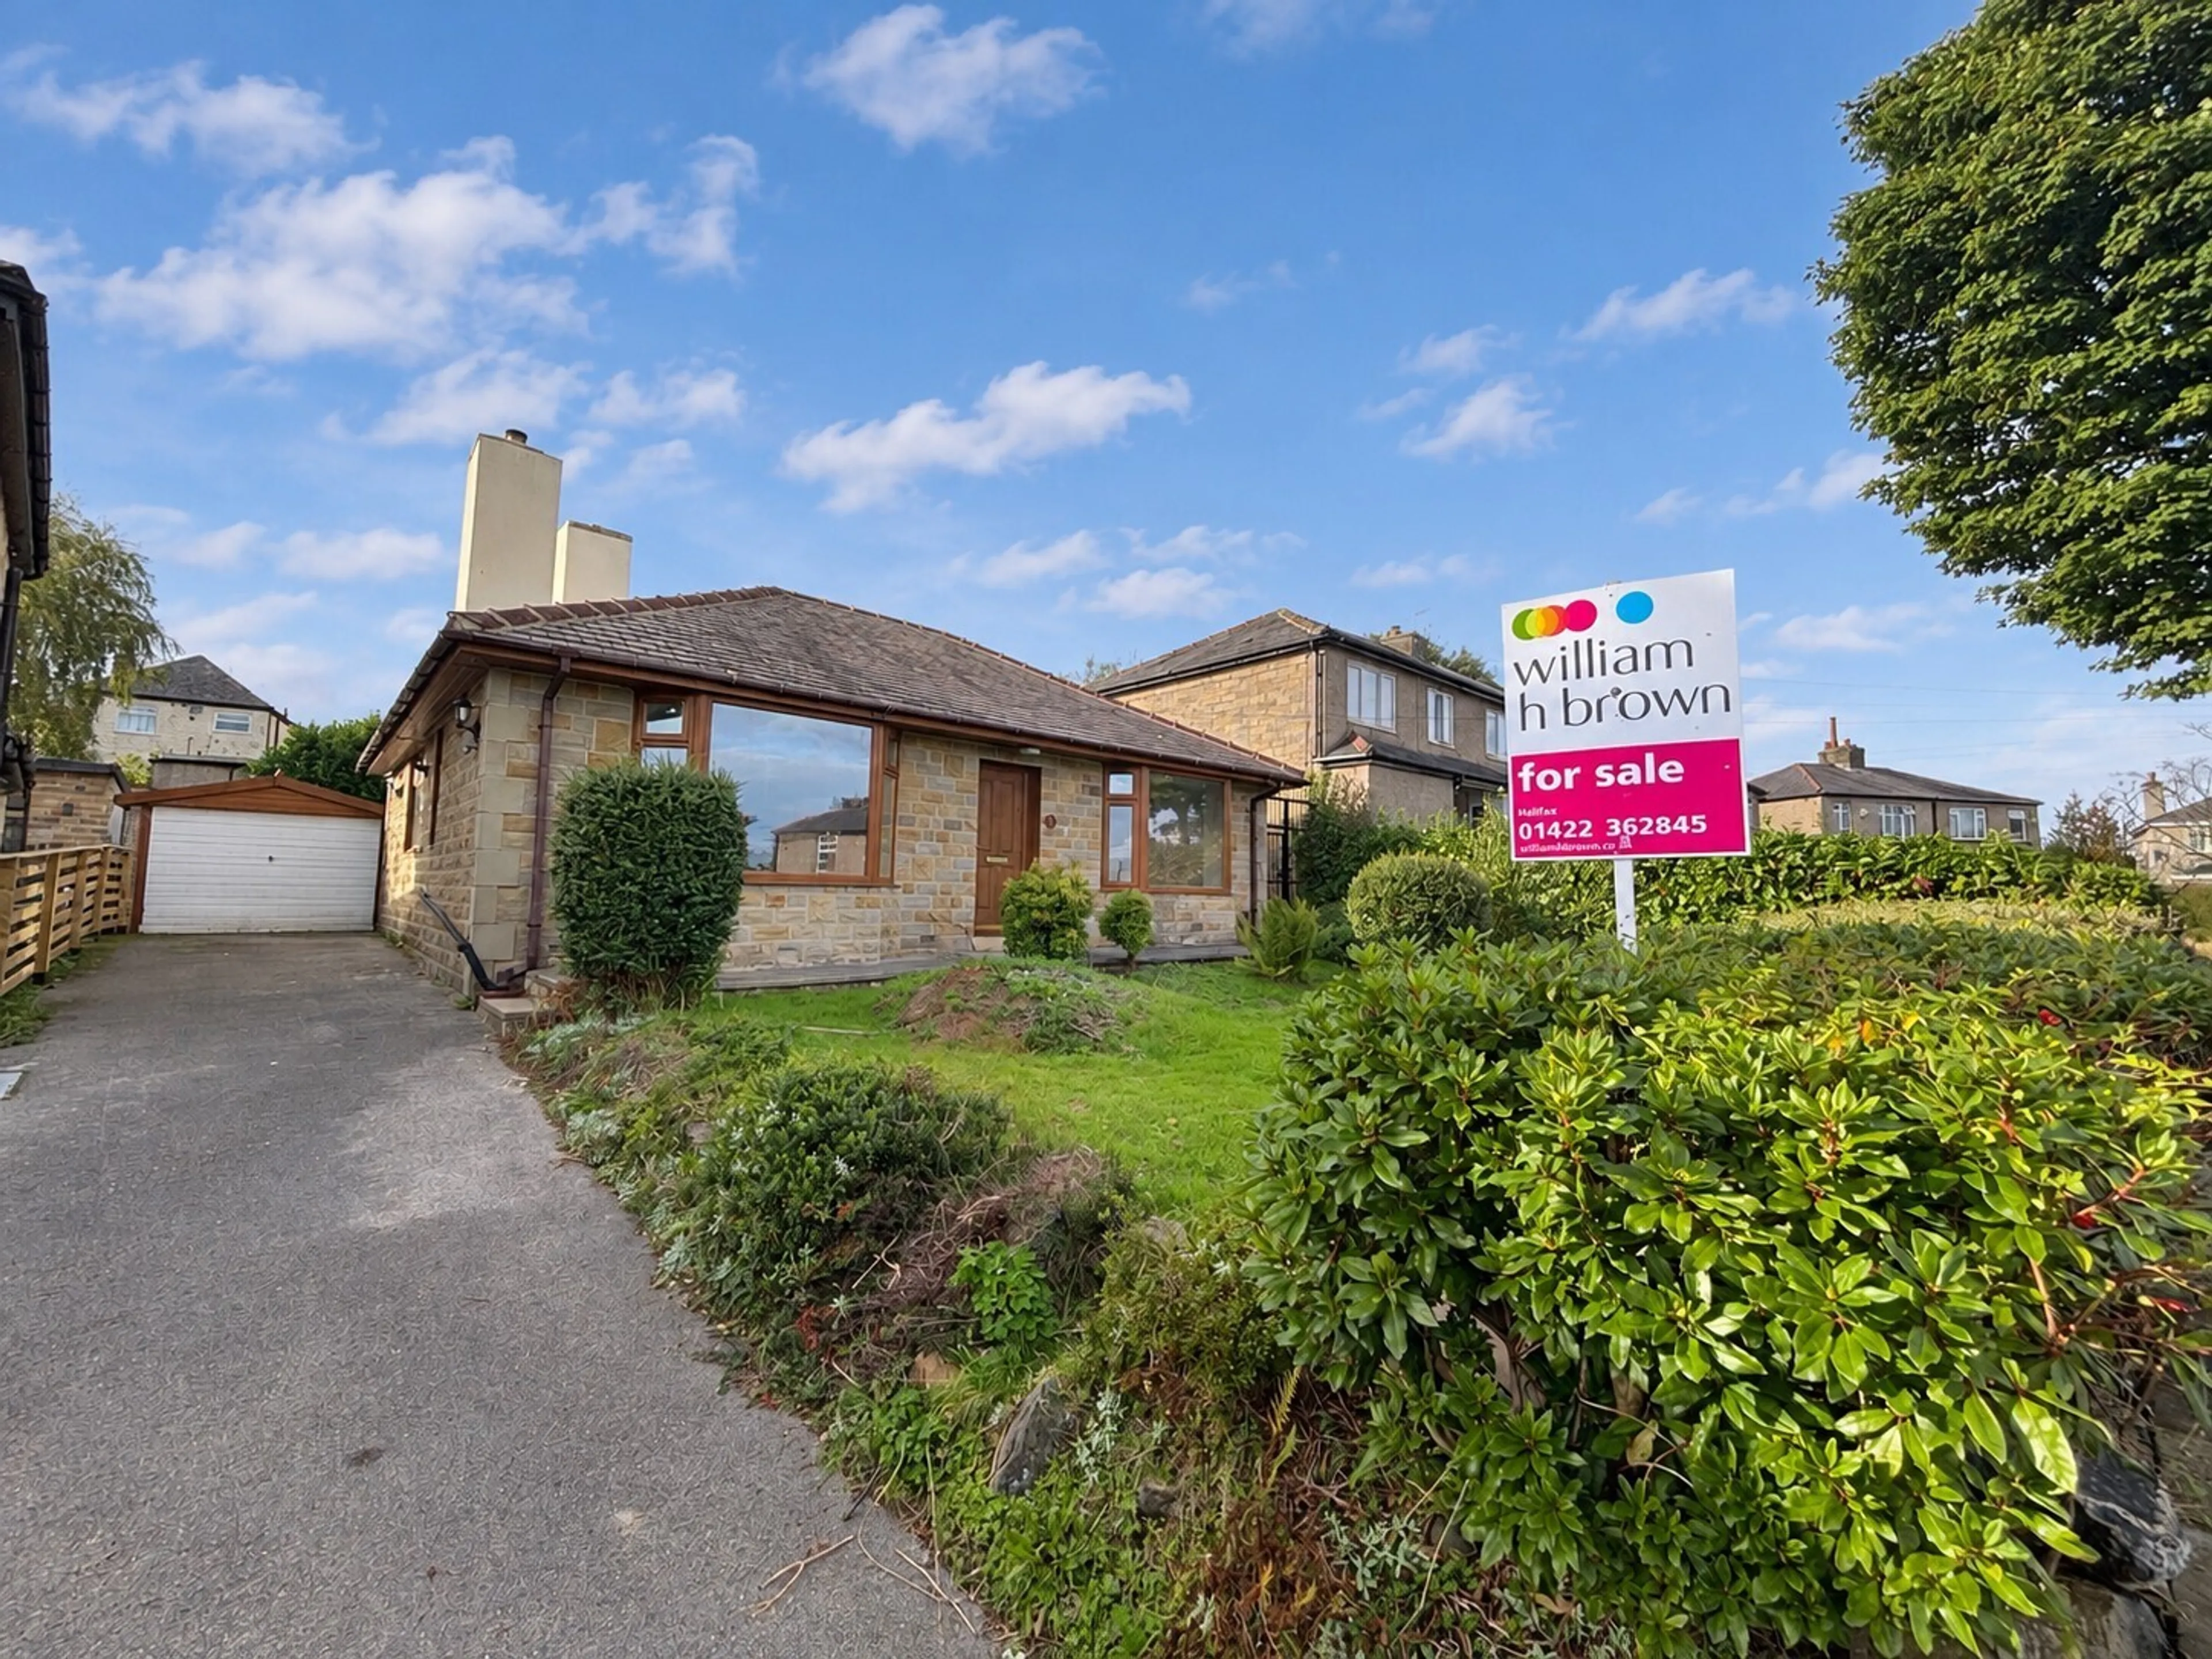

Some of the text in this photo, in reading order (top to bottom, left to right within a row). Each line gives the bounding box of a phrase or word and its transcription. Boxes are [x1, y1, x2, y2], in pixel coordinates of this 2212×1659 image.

[1513, 638, 1694, 686] william
[1520, 684, 1730, 731] h brown
[1517, 752, 1684, 792] for sale
[1518, 815, 1707, 840] 01422 362845
